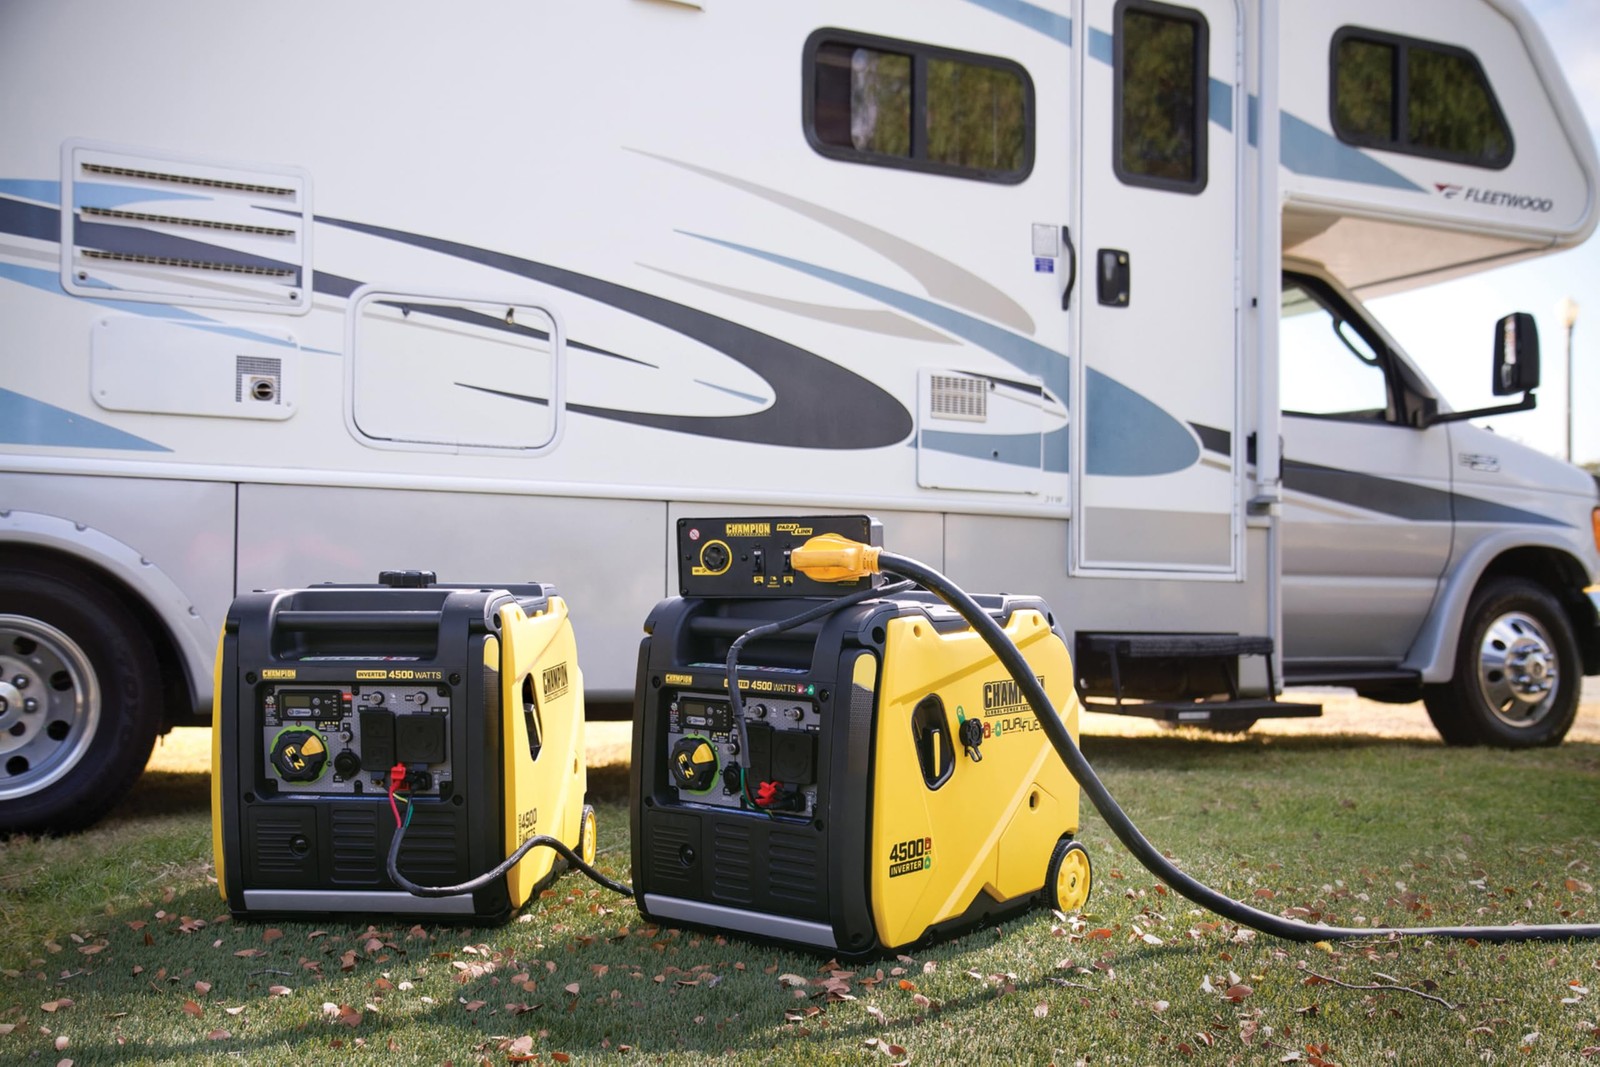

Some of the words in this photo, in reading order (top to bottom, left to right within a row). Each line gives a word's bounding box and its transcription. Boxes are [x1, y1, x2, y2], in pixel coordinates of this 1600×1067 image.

[1465, 188, 1553, 212] FLEETWOOD
[726, 523, 770, 534] CHAMPION
[262, 669, 296, 678] CHAMPION
[388, 670, 414, 679] 4500
[543, 664, 568, 694] CHAMPION
[751, 680, 772, 691] 4500
[773, 683, 796, 693] WATTS
[984, 678, 1044, 709] CHAMP
[1022, 718, 1043, 732] FUE
[889, 838, 924, 862] 4500
[890, 860, 922, 876] INVERTER
